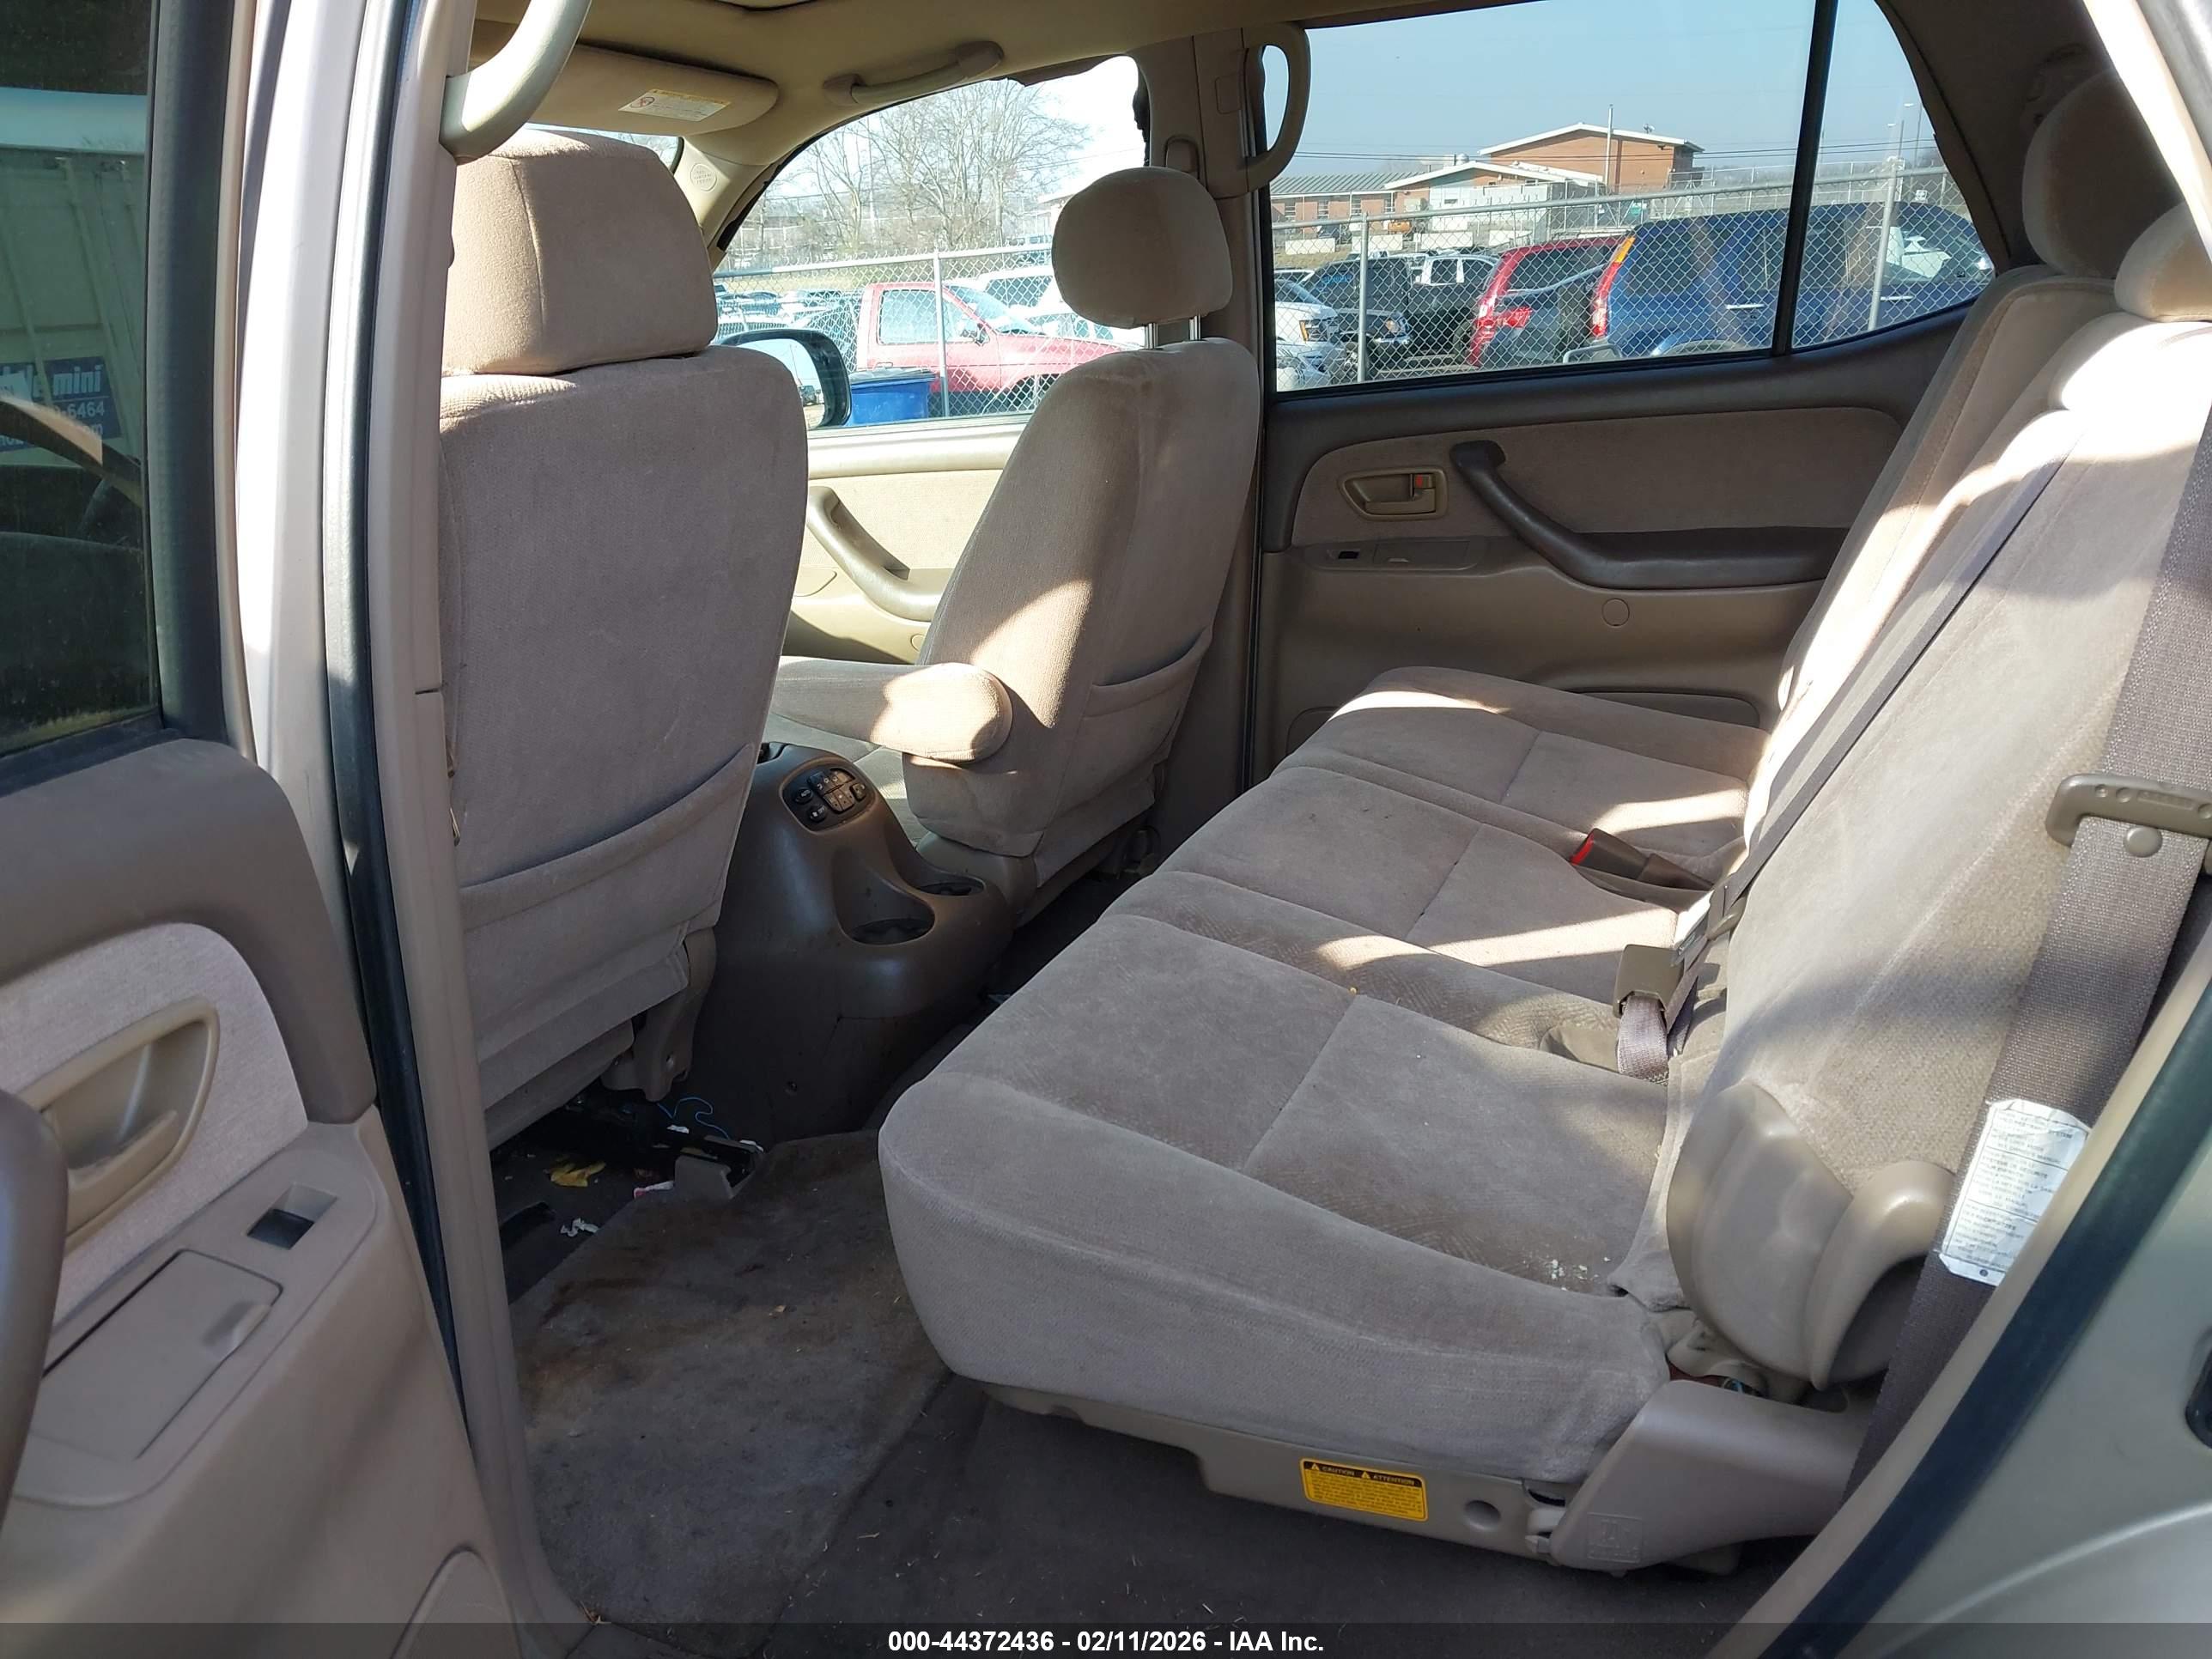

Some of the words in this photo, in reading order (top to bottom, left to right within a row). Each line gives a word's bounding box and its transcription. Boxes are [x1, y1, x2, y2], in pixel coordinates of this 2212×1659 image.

[52, 365, 102, 397] mini
[1322, 1466, 1355, 1476] CAUTION
[1373, 1474, 1415, 1486] ATTENTION
